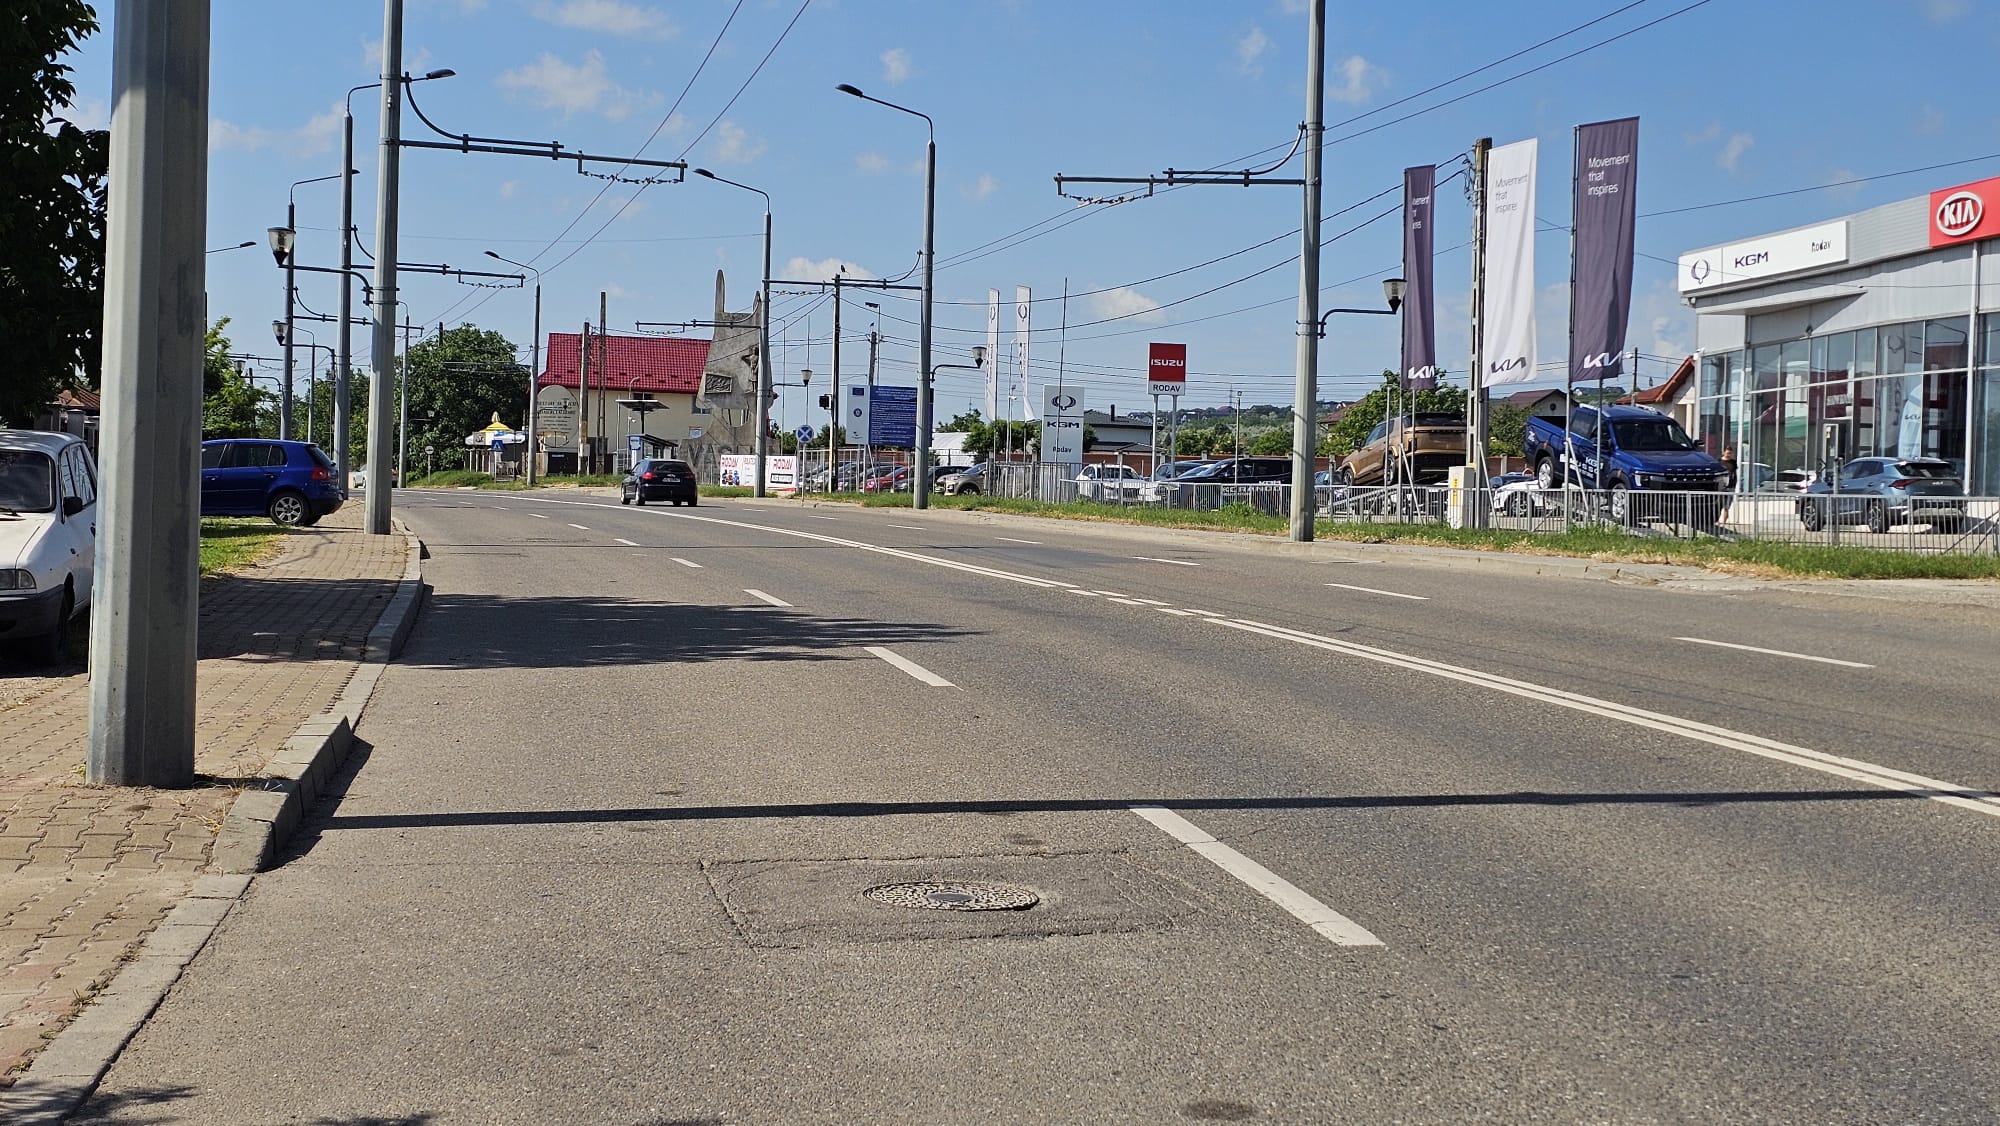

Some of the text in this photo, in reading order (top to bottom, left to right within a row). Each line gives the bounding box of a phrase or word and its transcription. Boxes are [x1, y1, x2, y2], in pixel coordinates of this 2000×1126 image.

[1588, 153, 1630, 169] Movement
[1495, 173, 1529, 189] Movement
[1588, 170, 1605, 182] that
[1495, 189, 1508, 201] that
[1588, 183, 1619, 197] inspires
[1943, 200, 1975, 226] KIA
[1734, 251, 1769, 269] KGM
[1150, 358, 1184, 367] ISUZU
[1490, 356, 1527, 374] KIA
[1583, 351, 1623, 369] KIA
[1408, 365, 1434, 379] KIA
[1153, 384, 1181, 392] RODAV
[1047, 421, 1080, 429] KGM
[1052, 446, 1073, 454] Rodav
